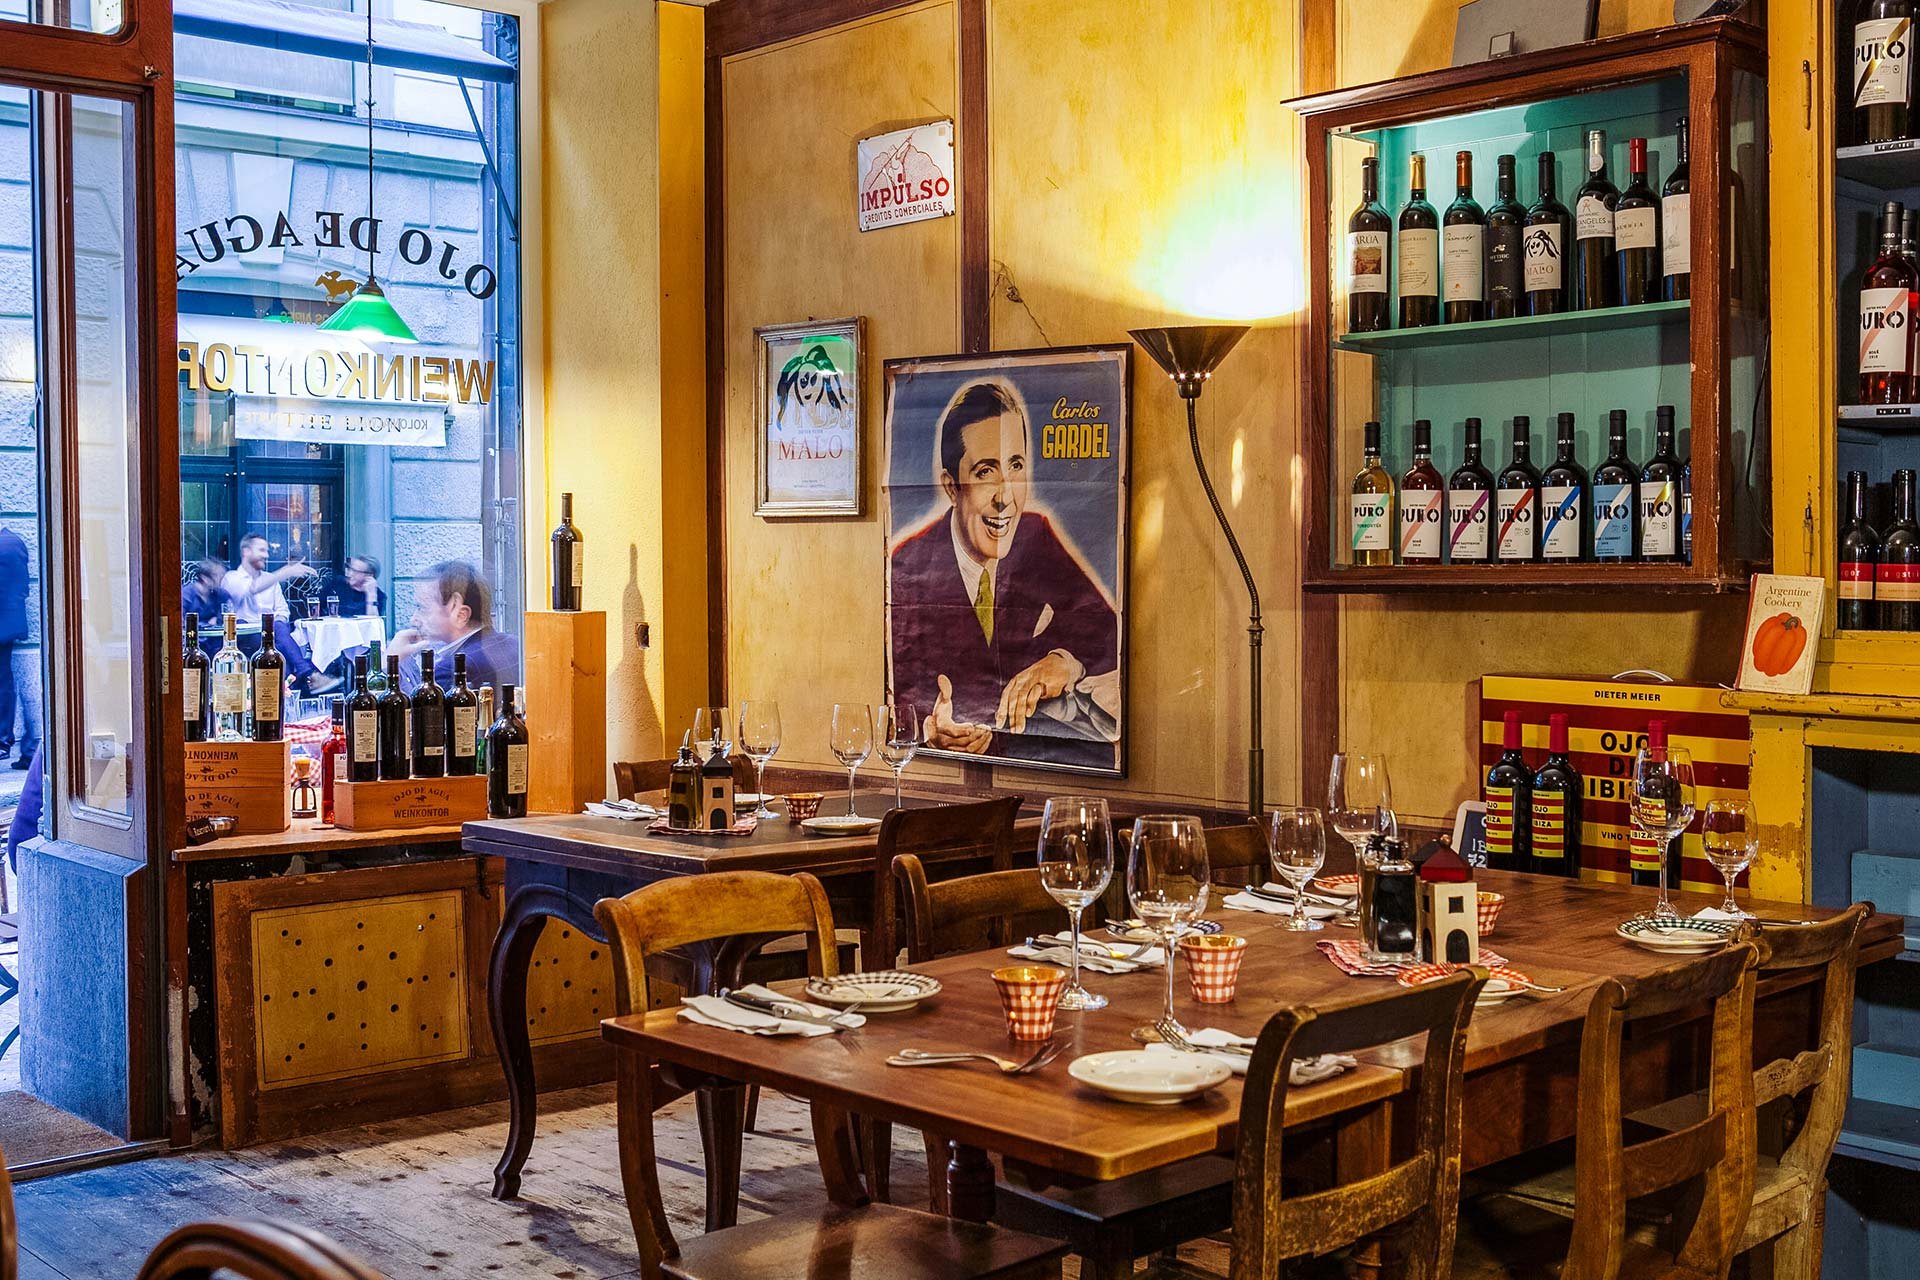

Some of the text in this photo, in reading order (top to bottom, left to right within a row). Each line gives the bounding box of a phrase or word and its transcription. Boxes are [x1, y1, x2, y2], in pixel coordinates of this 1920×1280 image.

[1856, 41, 1906, 64] PURO
[861, 177, 950, 212] IMPULSO
[895, 201, 944, 218] COMERCIALES
[1051, 395, 1101, 420] Carlos
[1042, 422, 1111, 459] GARDEL
[778, 434, 842, 462] MALO
[1354, 506, 1385, 518] PURO
[1766, 585, 1811, 598] Argentine
[1764, 596, 1802, 608] Cookery
[1594, 690, 1661, 702] DIETER MEIER
[184, 751, 239, 760] WEINKONTO
[394, 786, 450, 802] OJO DE AGUA
[394, 808, 449, 818] WEINKONTOR
[1602, 831, 1623, 841] VINO
